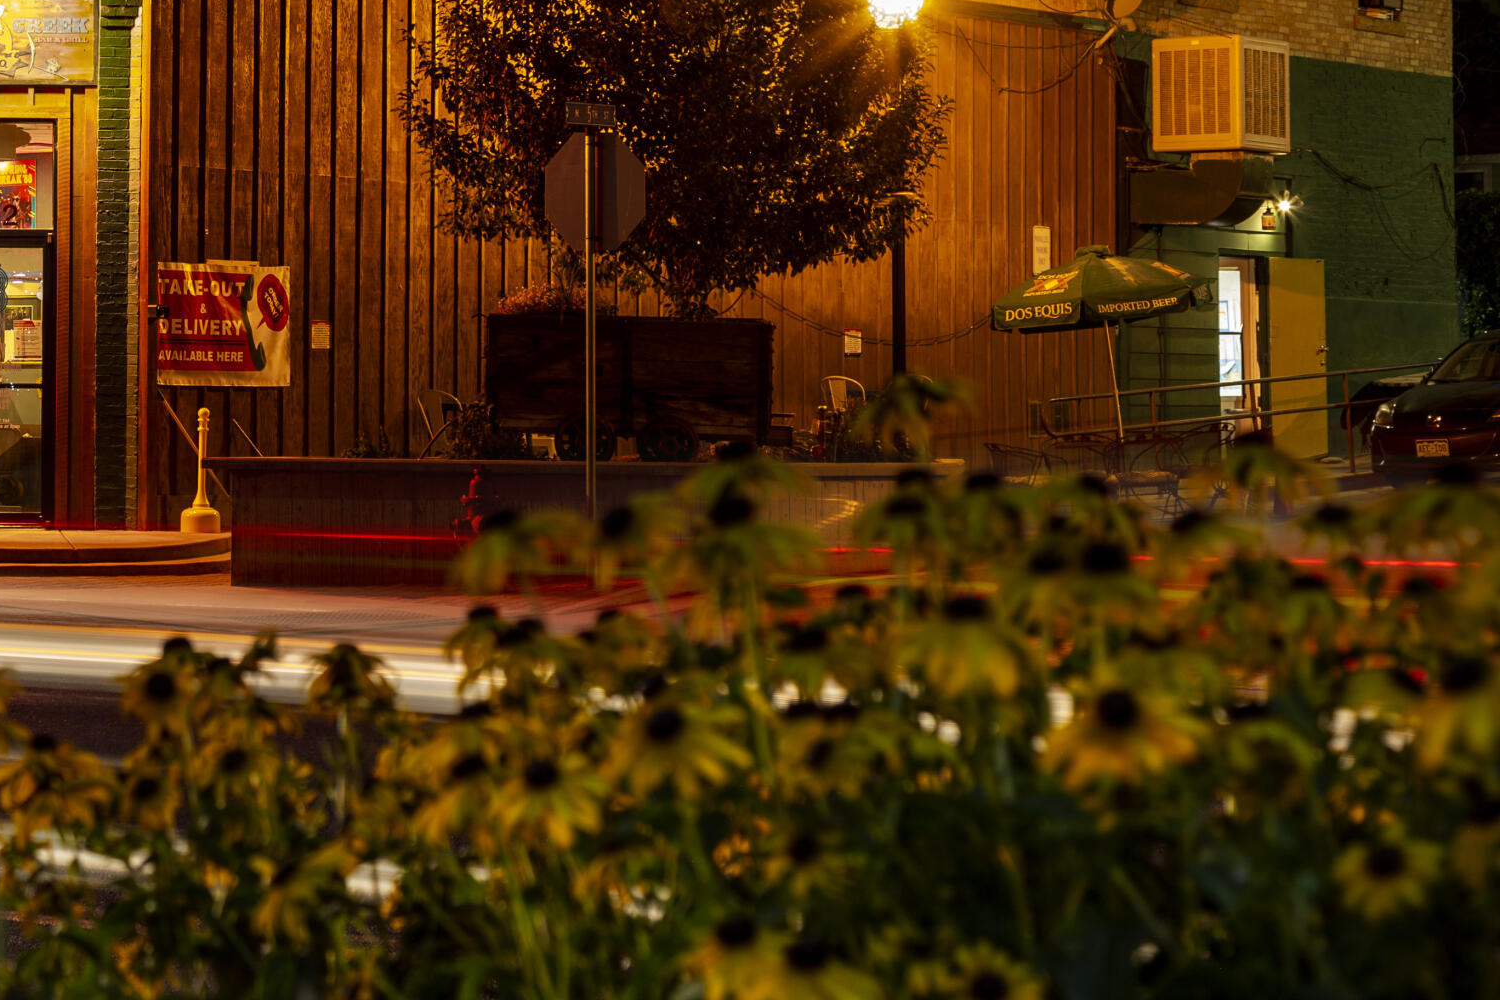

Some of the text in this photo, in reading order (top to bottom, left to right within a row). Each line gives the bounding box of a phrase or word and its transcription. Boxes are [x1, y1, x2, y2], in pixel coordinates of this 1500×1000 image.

[12, 16, 90, 34] CREEK
[159, 278, 245, 297] TAKE-OUT
[200, 303, 207, 314] &
[264, 292, 280, 318] TODAY!
[268, 287, 284, 313] ORDER
[1098, 297, 1178, 314] IMPORTED BEER
[1005, 302, 1073, 322] DOS EQUIS
[159, 318, 243, 336] DELIVERY
[158, 350, 244, 362] AVAILABLE HERE
